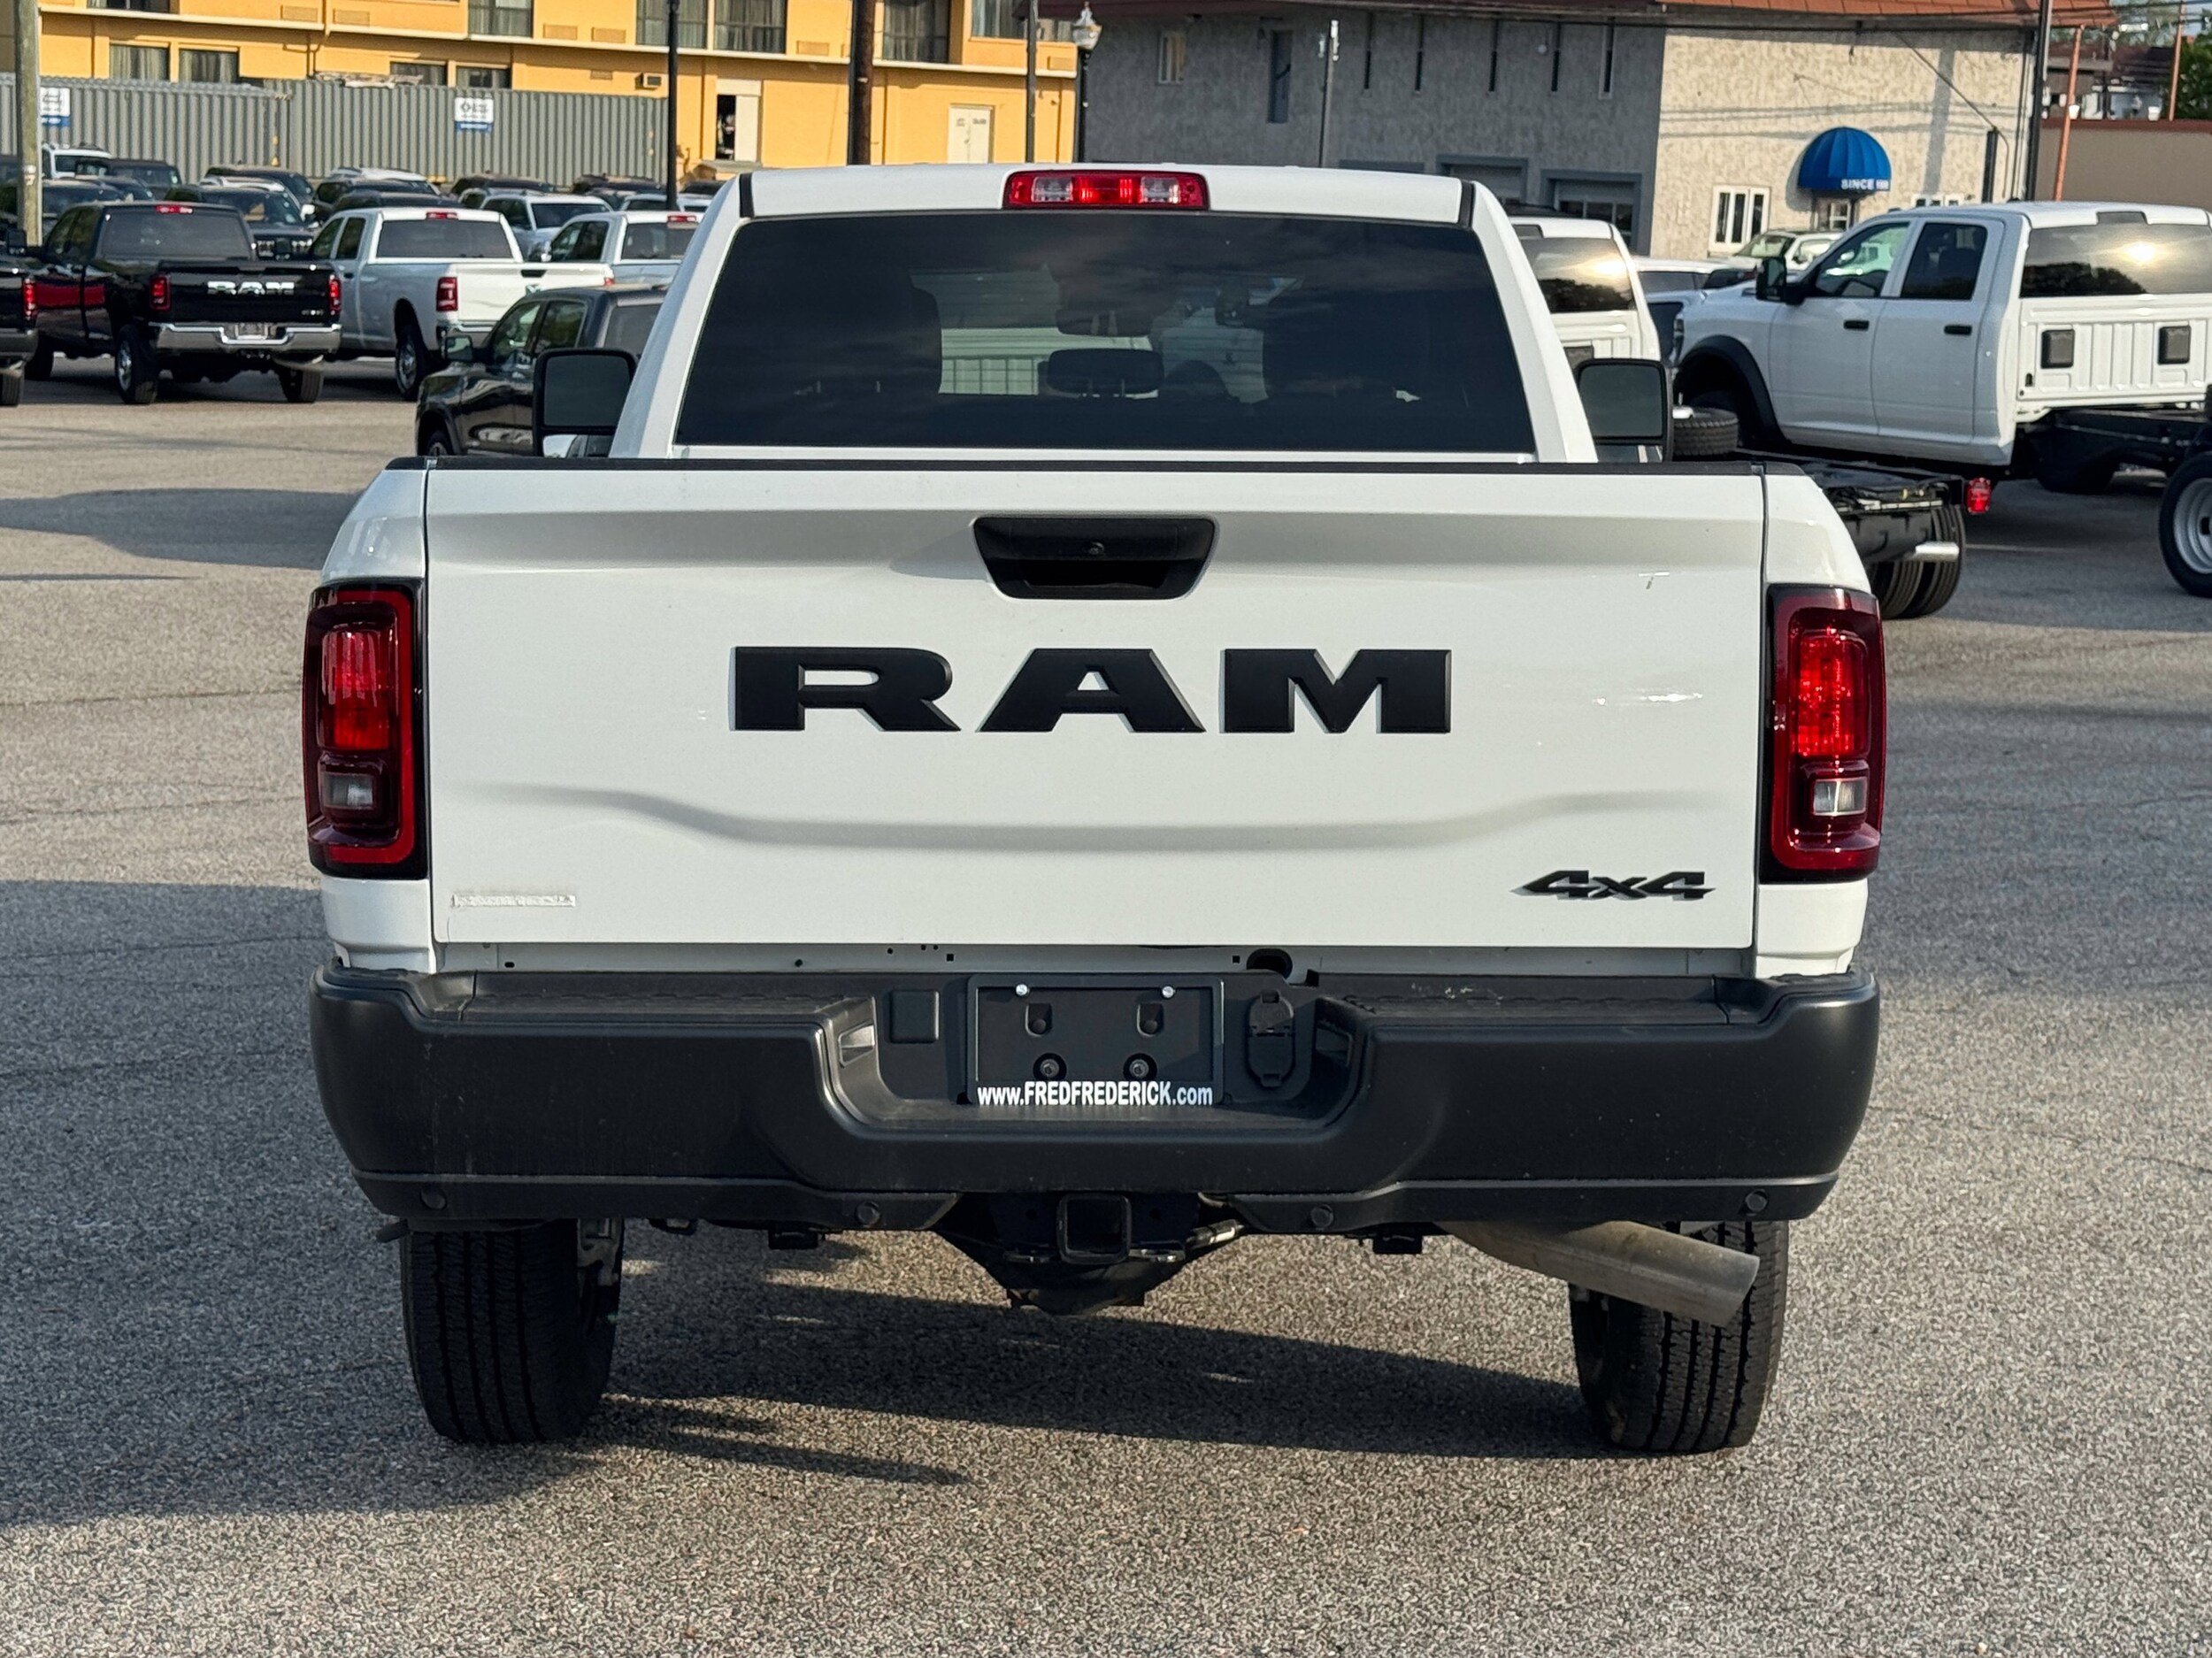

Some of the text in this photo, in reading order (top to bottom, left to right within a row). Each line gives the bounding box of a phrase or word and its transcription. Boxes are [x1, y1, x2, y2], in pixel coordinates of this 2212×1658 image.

[1841, 179, 1875, 190] SINCE
[207, 280, 295, 295] RAM
[732, 647, 1452, 733] RAM
[1519, 870, 1717, 900] 4x4
[977, 1080, 1213, 1106] www.FREDFREDERICK.com
